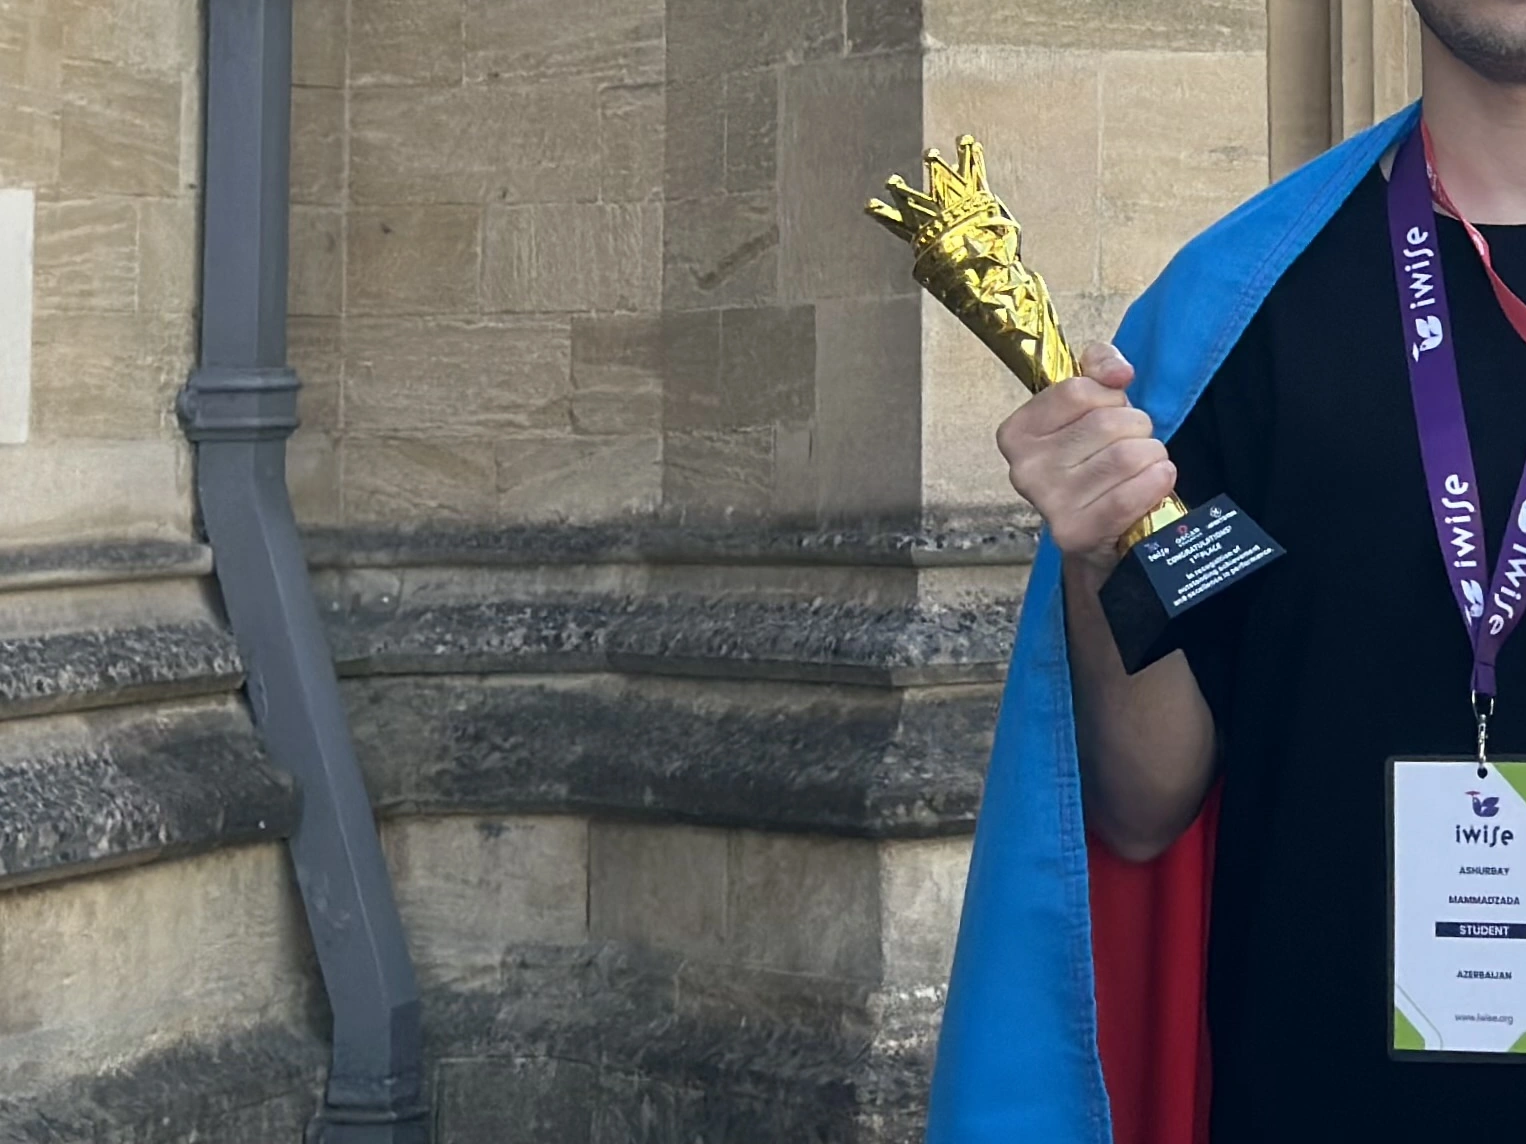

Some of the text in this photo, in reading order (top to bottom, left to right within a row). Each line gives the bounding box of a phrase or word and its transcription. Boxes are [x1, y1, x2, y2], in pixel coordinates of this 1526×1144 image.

[1459, 866, 1510, 876] ASHURBAY
[1448, 895, 1520, 905] MAMMADZADA
[1459, 924, 1509, 936] STUDENT
[1456, 970, 1512, 980] AZERBAIJAN
